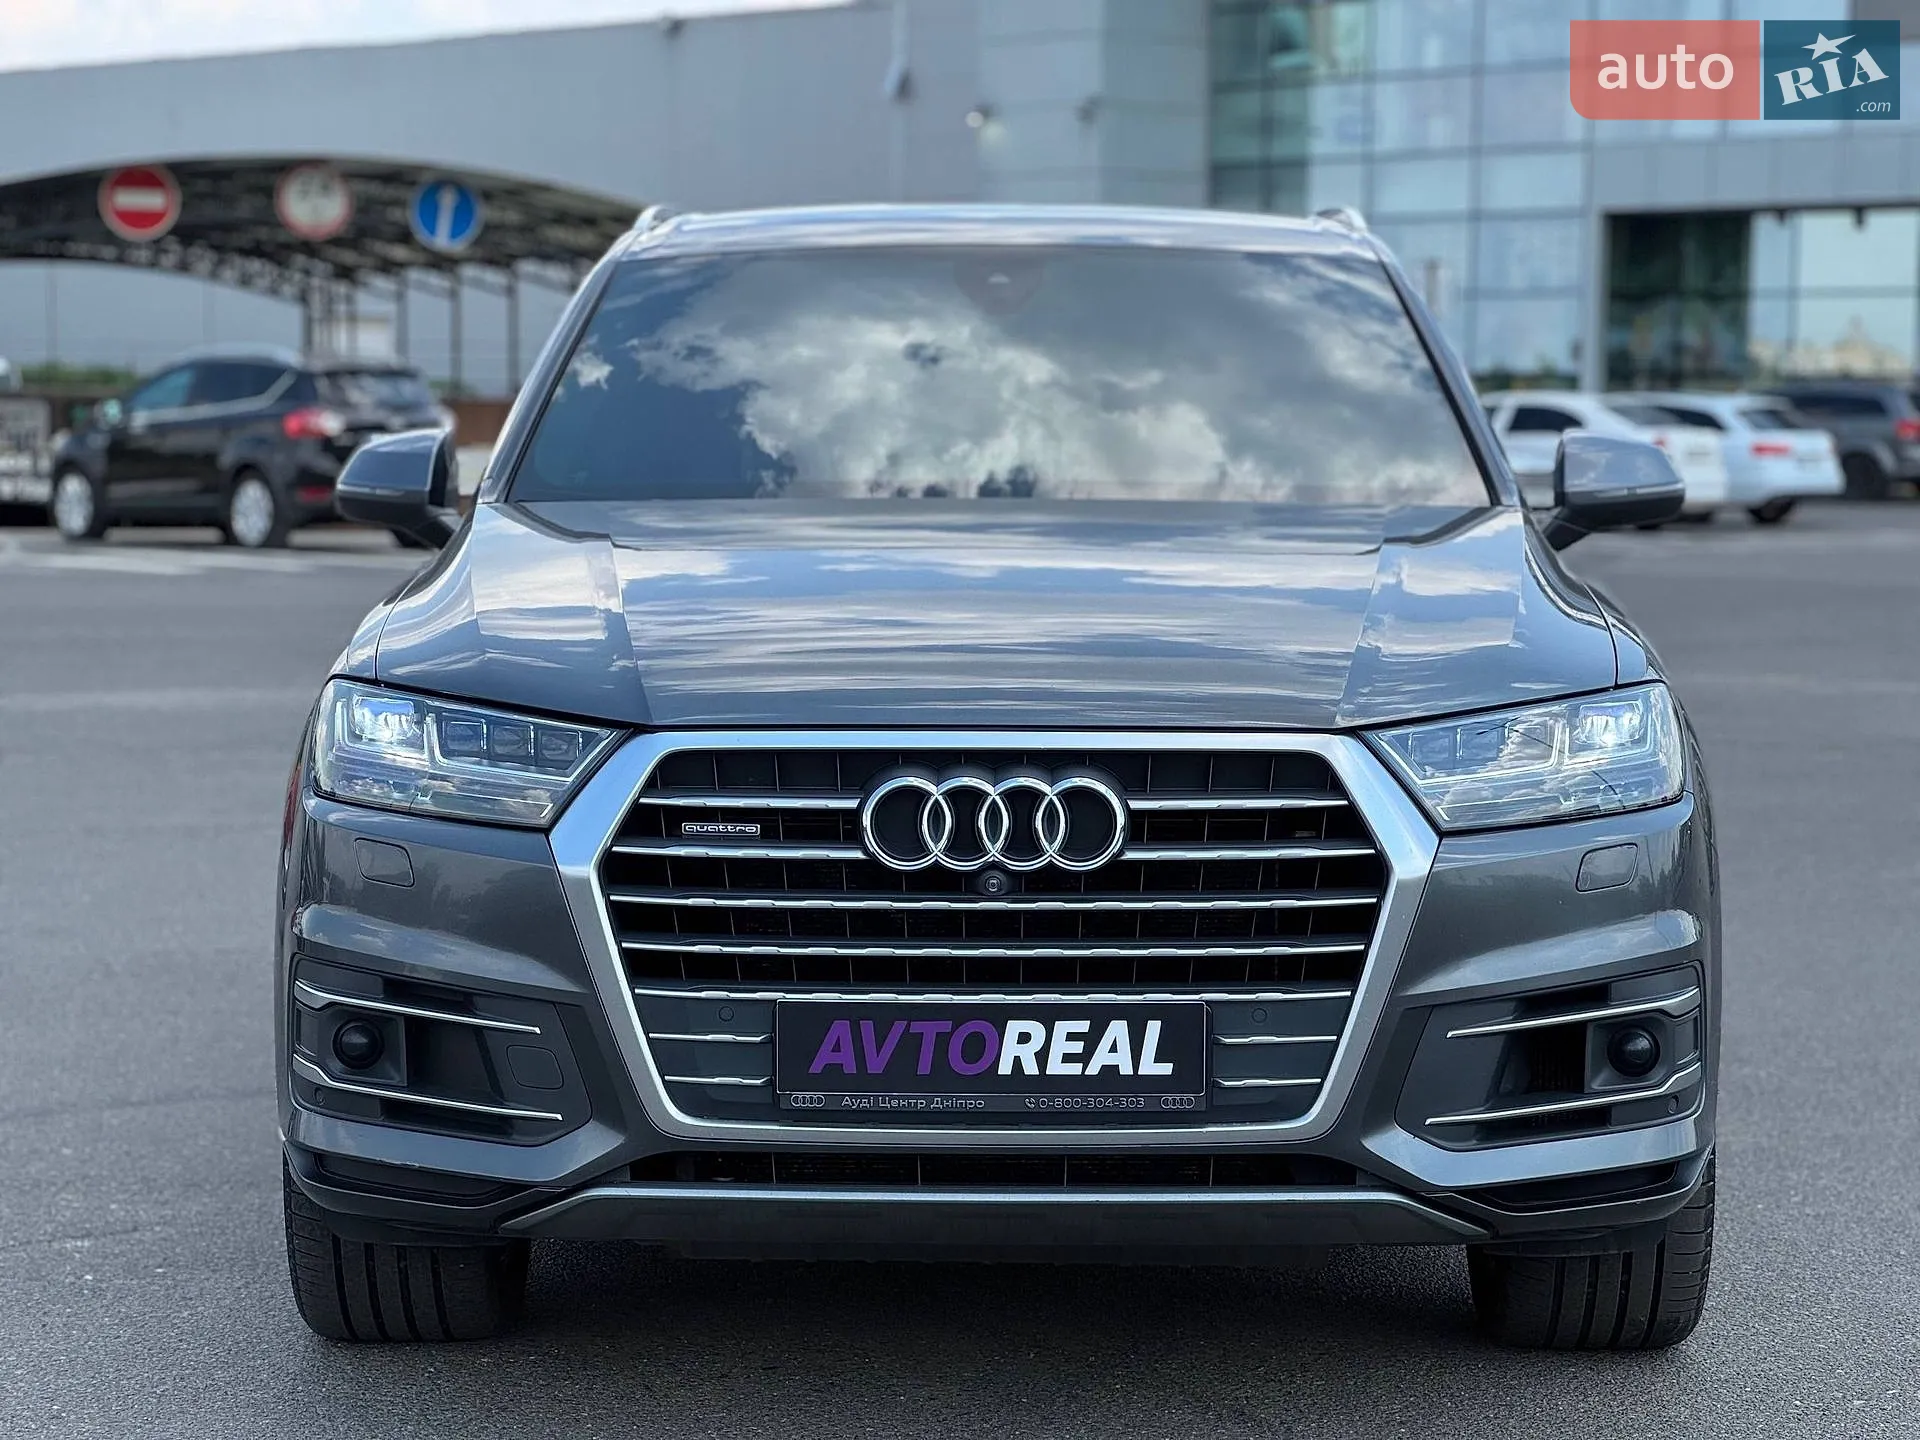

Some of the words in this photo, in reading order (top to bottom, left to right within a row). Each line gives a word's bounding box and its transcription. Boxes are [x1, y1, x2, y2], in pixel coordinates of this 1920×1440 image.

[685, 825, 756, 833] quattro
[808, 1019, 1174, 1075] AVTOREAL
[841, 1096, 874, 1109] Ауді
[879, 1097, 926, 1109] Центр
[930, 1098, 985, 1110] Дніпро
[1039, 1097, 1145, 1108] 0-800-304-303
